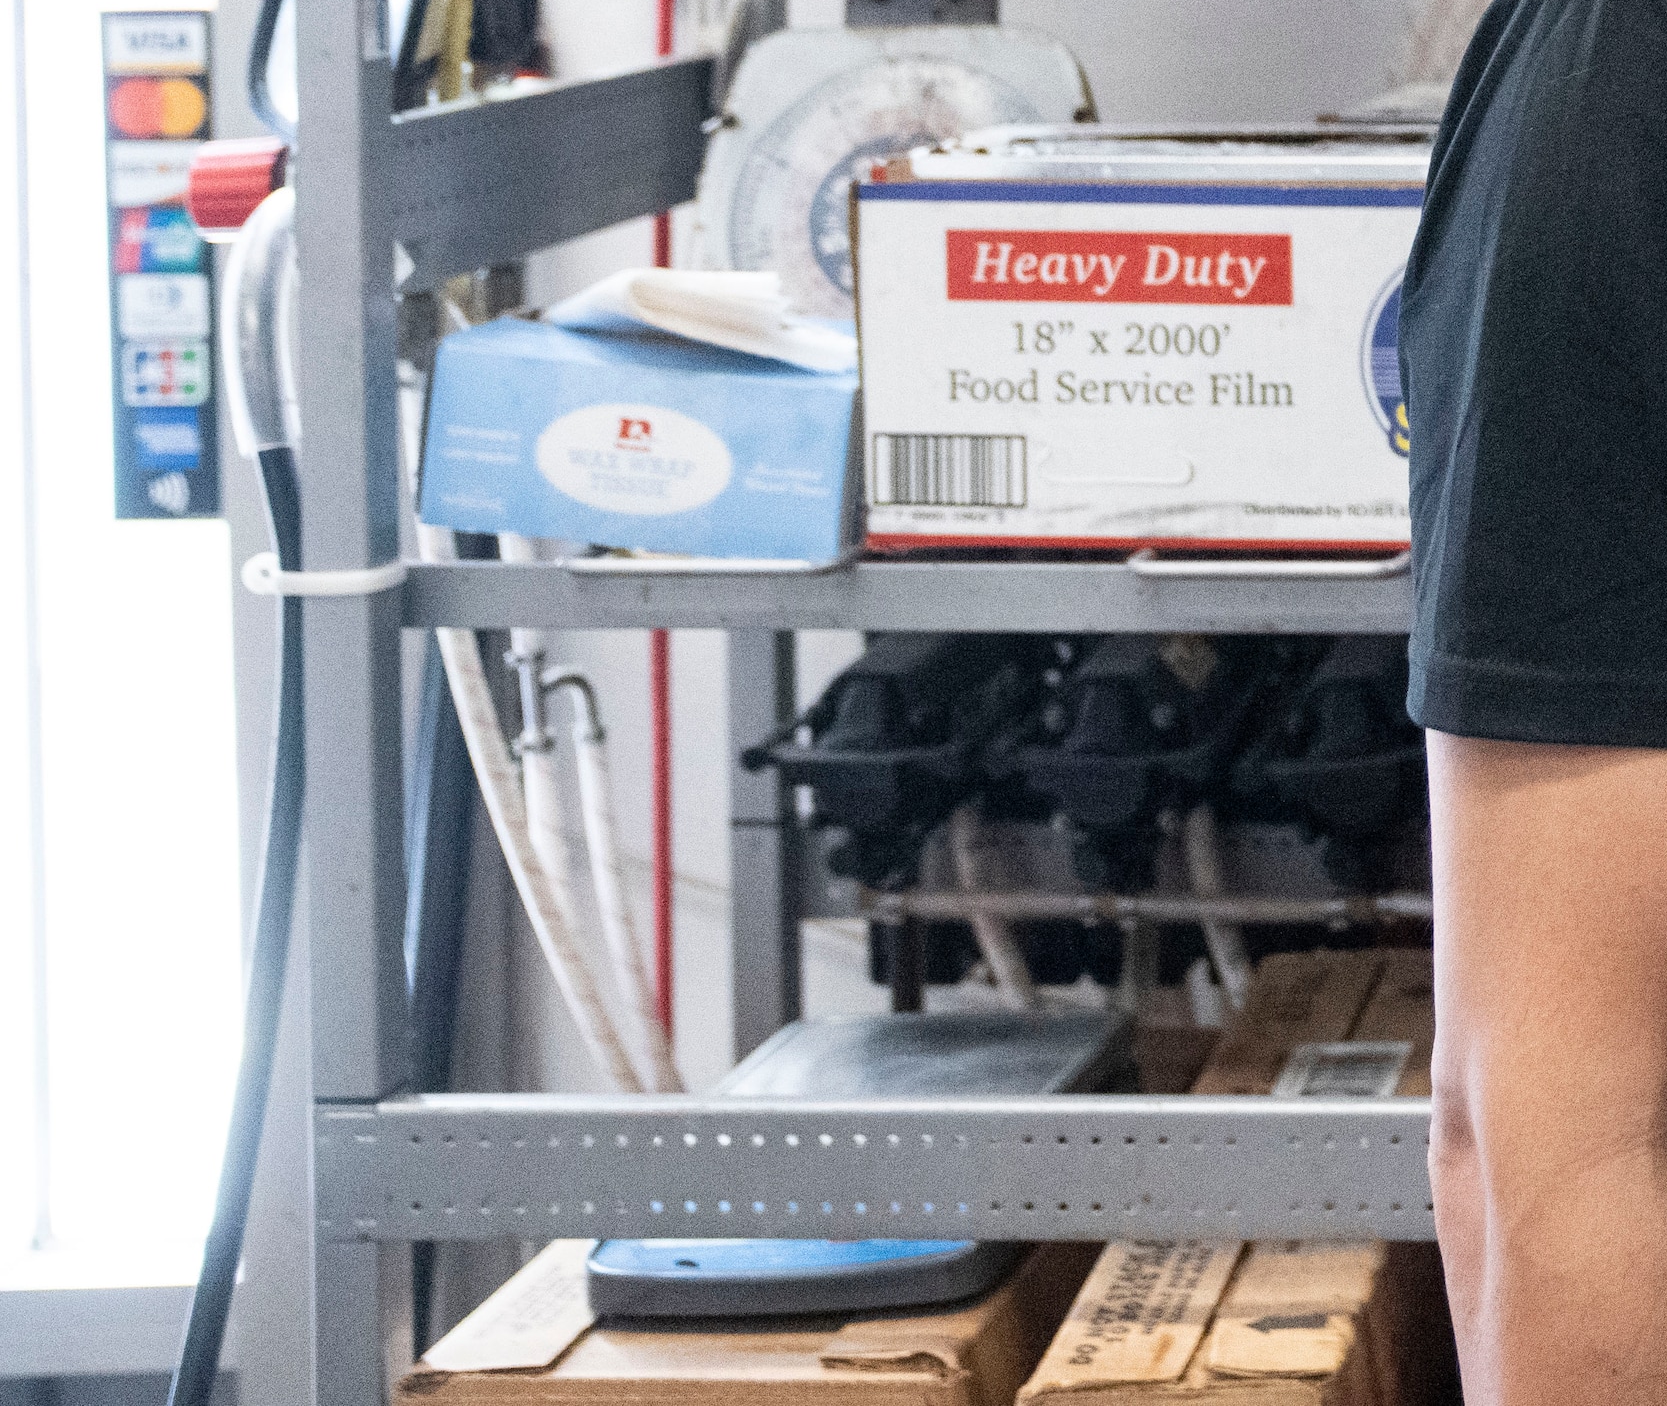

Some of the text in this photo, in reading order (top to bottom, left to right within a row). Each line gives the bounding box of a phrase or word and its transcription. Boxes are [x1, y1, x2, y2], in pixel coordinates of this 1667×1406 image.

[971, 239, 1267, 298] Heavy Duty
[1088, 332, 1111, 356] x
[948, 369, 1295, 407] Food Service Film
